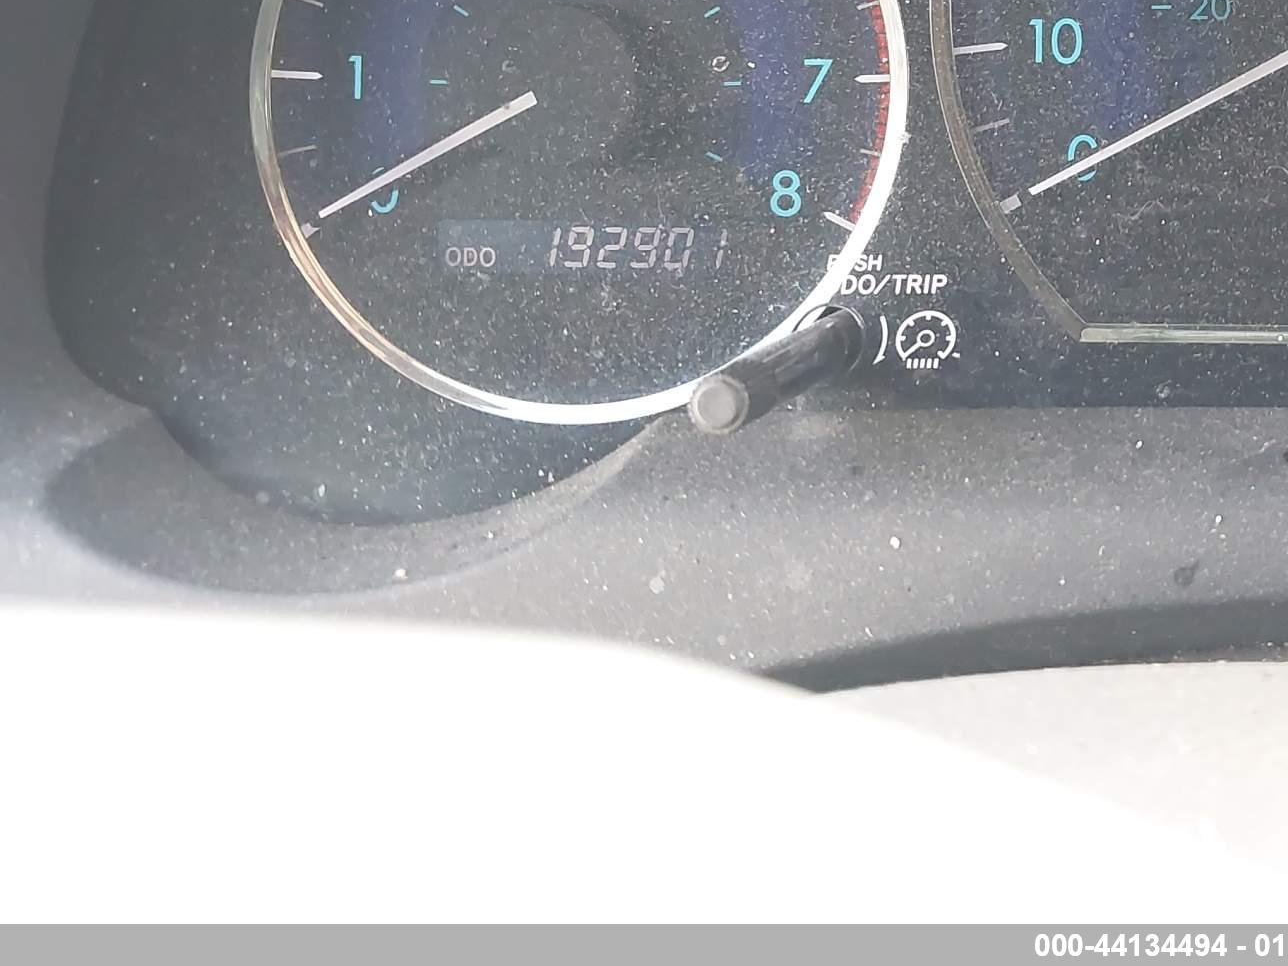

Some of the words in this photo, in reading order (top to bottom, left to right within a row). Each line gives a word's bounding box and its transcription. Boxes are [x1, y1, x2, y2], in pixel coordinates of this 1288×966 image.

[1029, 17, 1083, 65] 10
[349, 54, 364, 100] 1
[803, 58, 832, 104] 7
[1067, 134, 1098, 183] 0
[770, 170, 801, 218] 8
[446, 247, 496, 267] ODO
[550, 226, 727, 269] 192901
